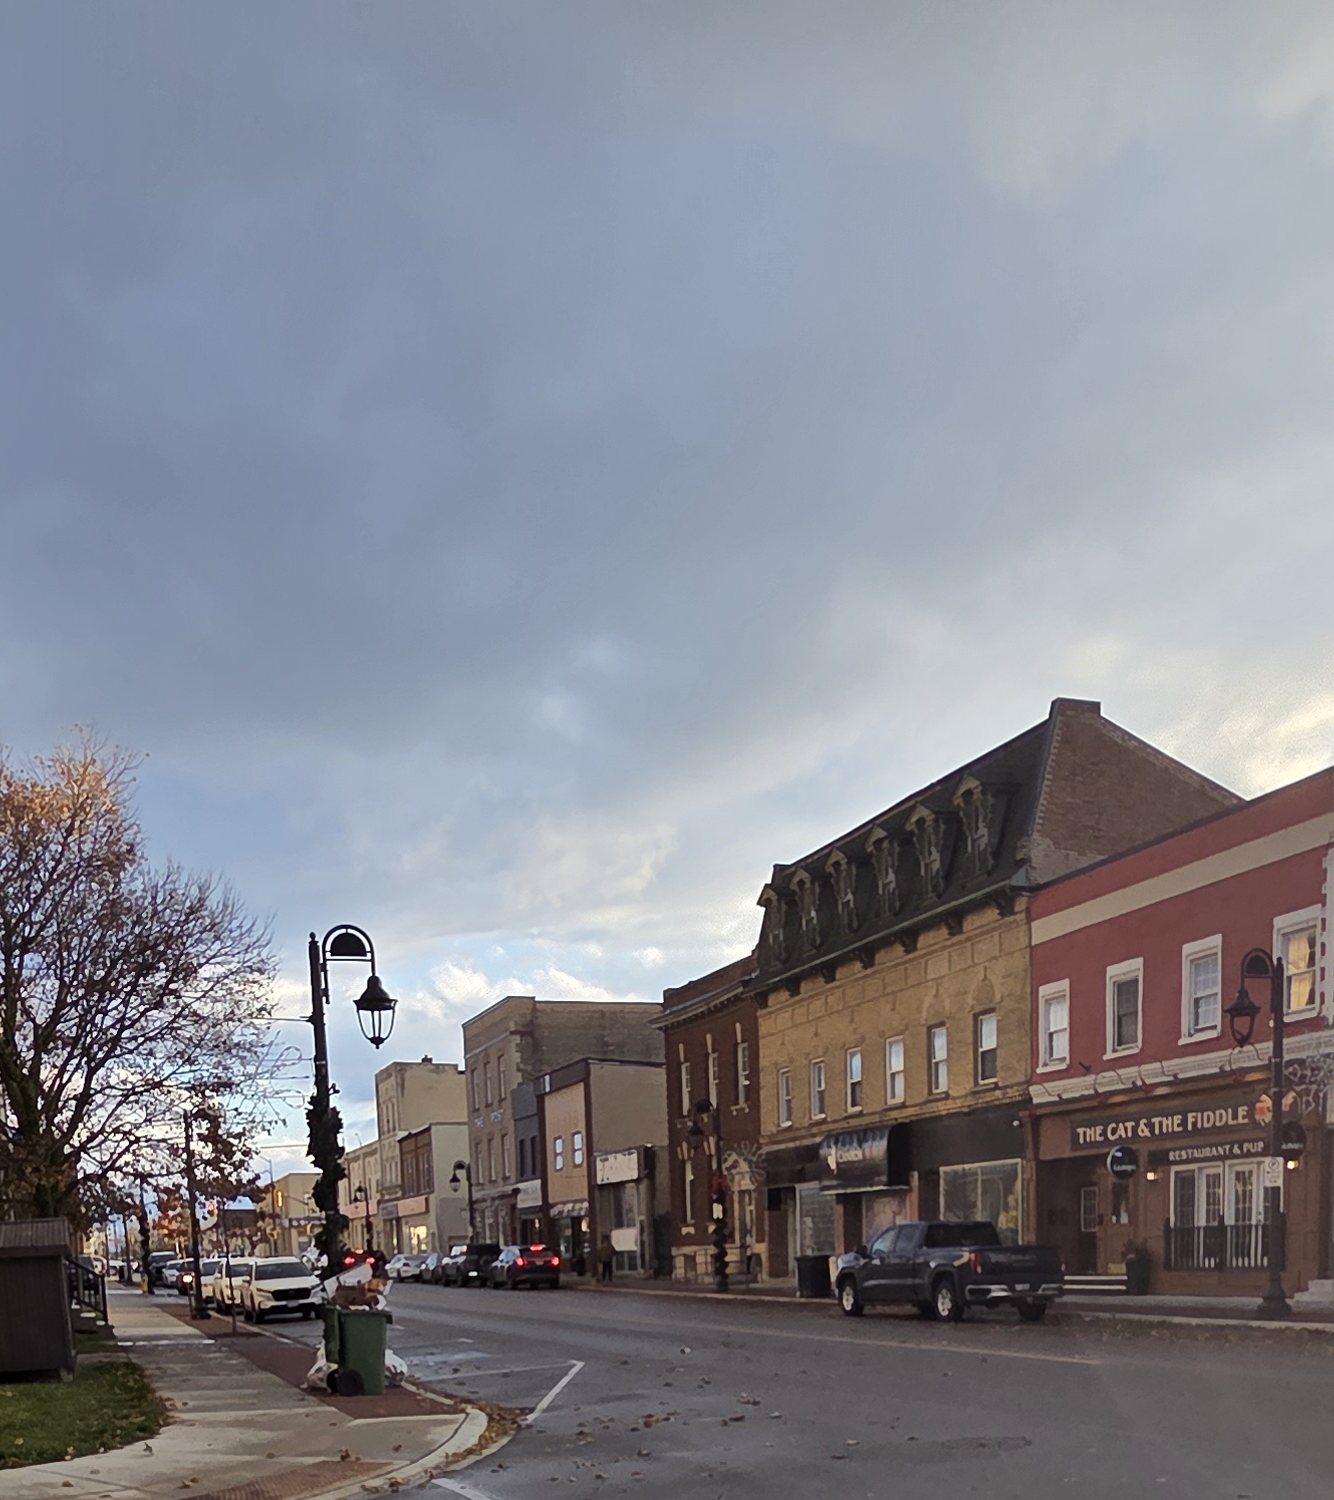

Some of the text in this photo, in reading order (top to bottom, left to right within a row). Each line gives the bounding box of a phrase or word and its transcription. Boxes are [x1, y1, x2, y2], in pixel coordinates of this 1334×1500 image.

[1076, 1105, 1249, 1144] THE CAT & THE FIDDLE
[1169, 1144, 1230, 1161] RESTAURANT
[1232, 1143, 1241, 1155] &
